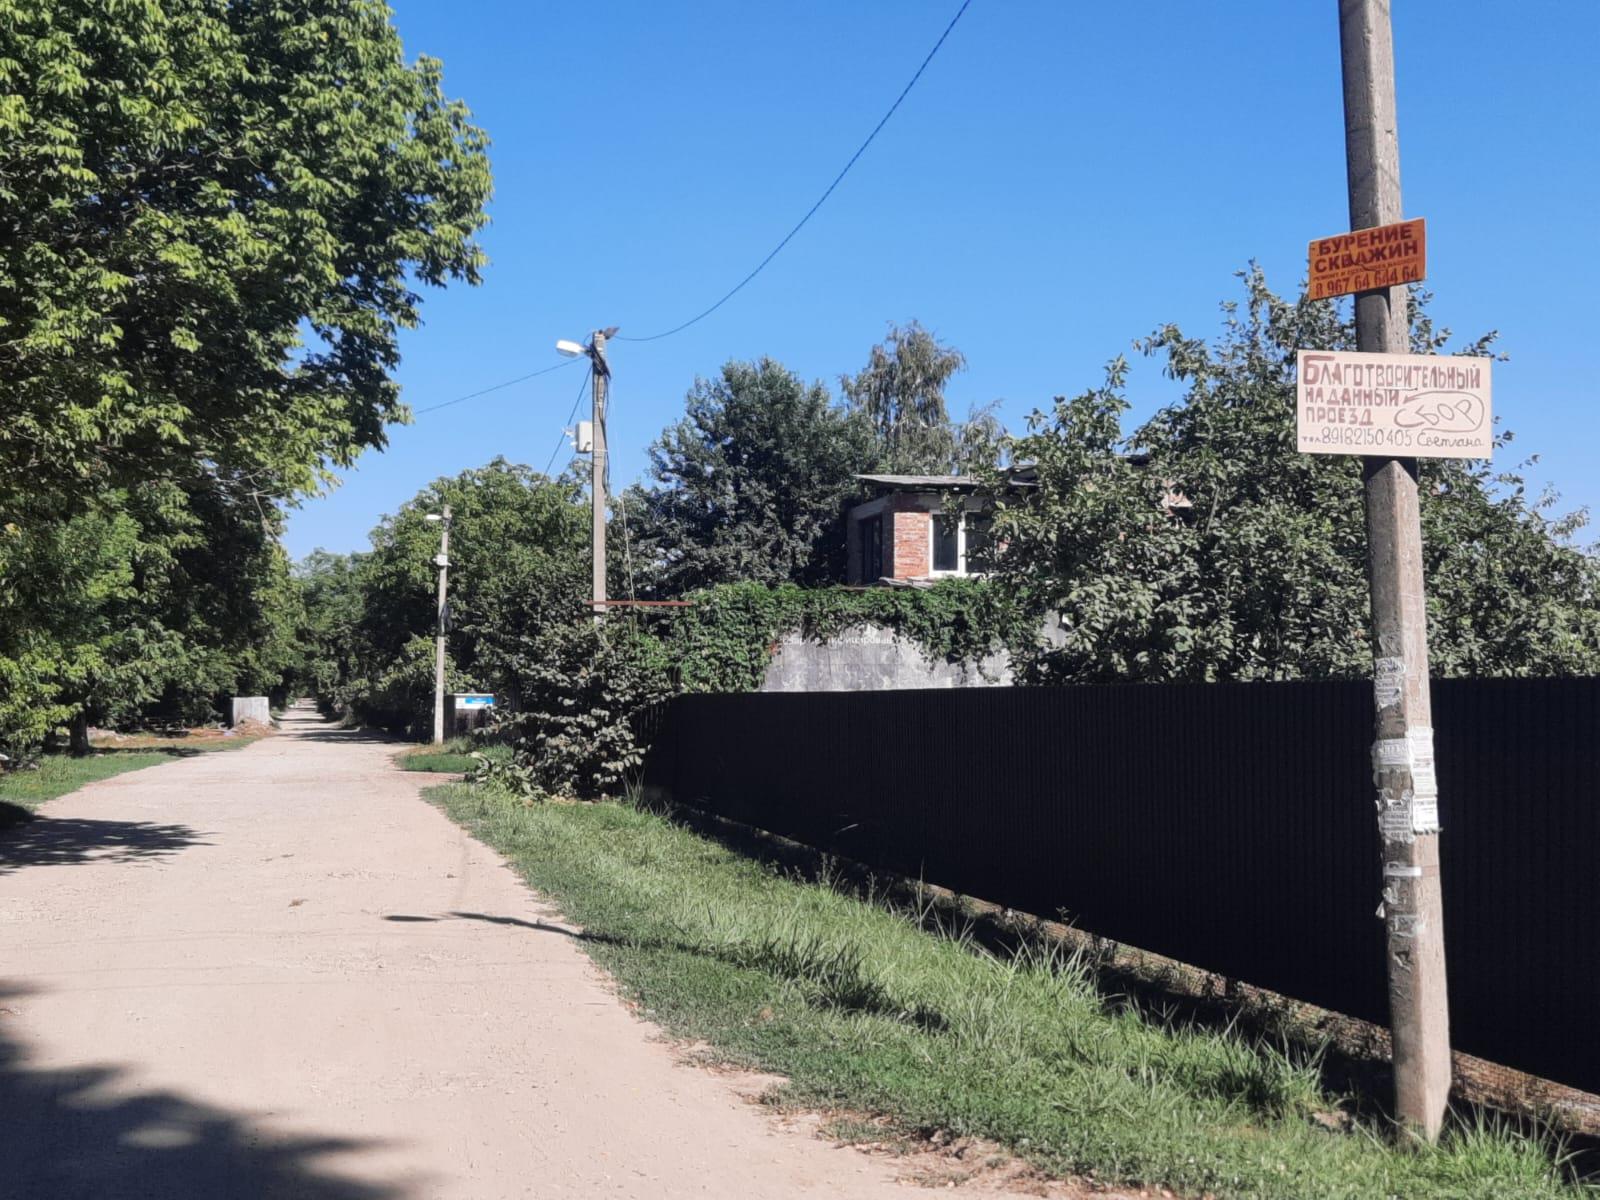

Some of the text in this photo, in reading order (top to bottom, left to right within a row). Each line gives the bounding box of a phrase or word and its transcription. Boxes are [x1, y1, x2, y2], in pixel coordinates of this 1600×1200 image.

[1318, 223, 1414, 256] БУРЕНИЕ
[1314, 240, 1418, 273] СКВАЖИН
[1303, 354, 1481, 389] БЛАГОТВОРИТЕЛЬНЫЙ
[1305, 386, 1400, 407] НА ДАННЫЙ
[1306, 406, 1374, 426] ПРОЕЗД
[1394, 398, 1476, 428] СБОР
[1417, 431, 1485, 448] Светлана
